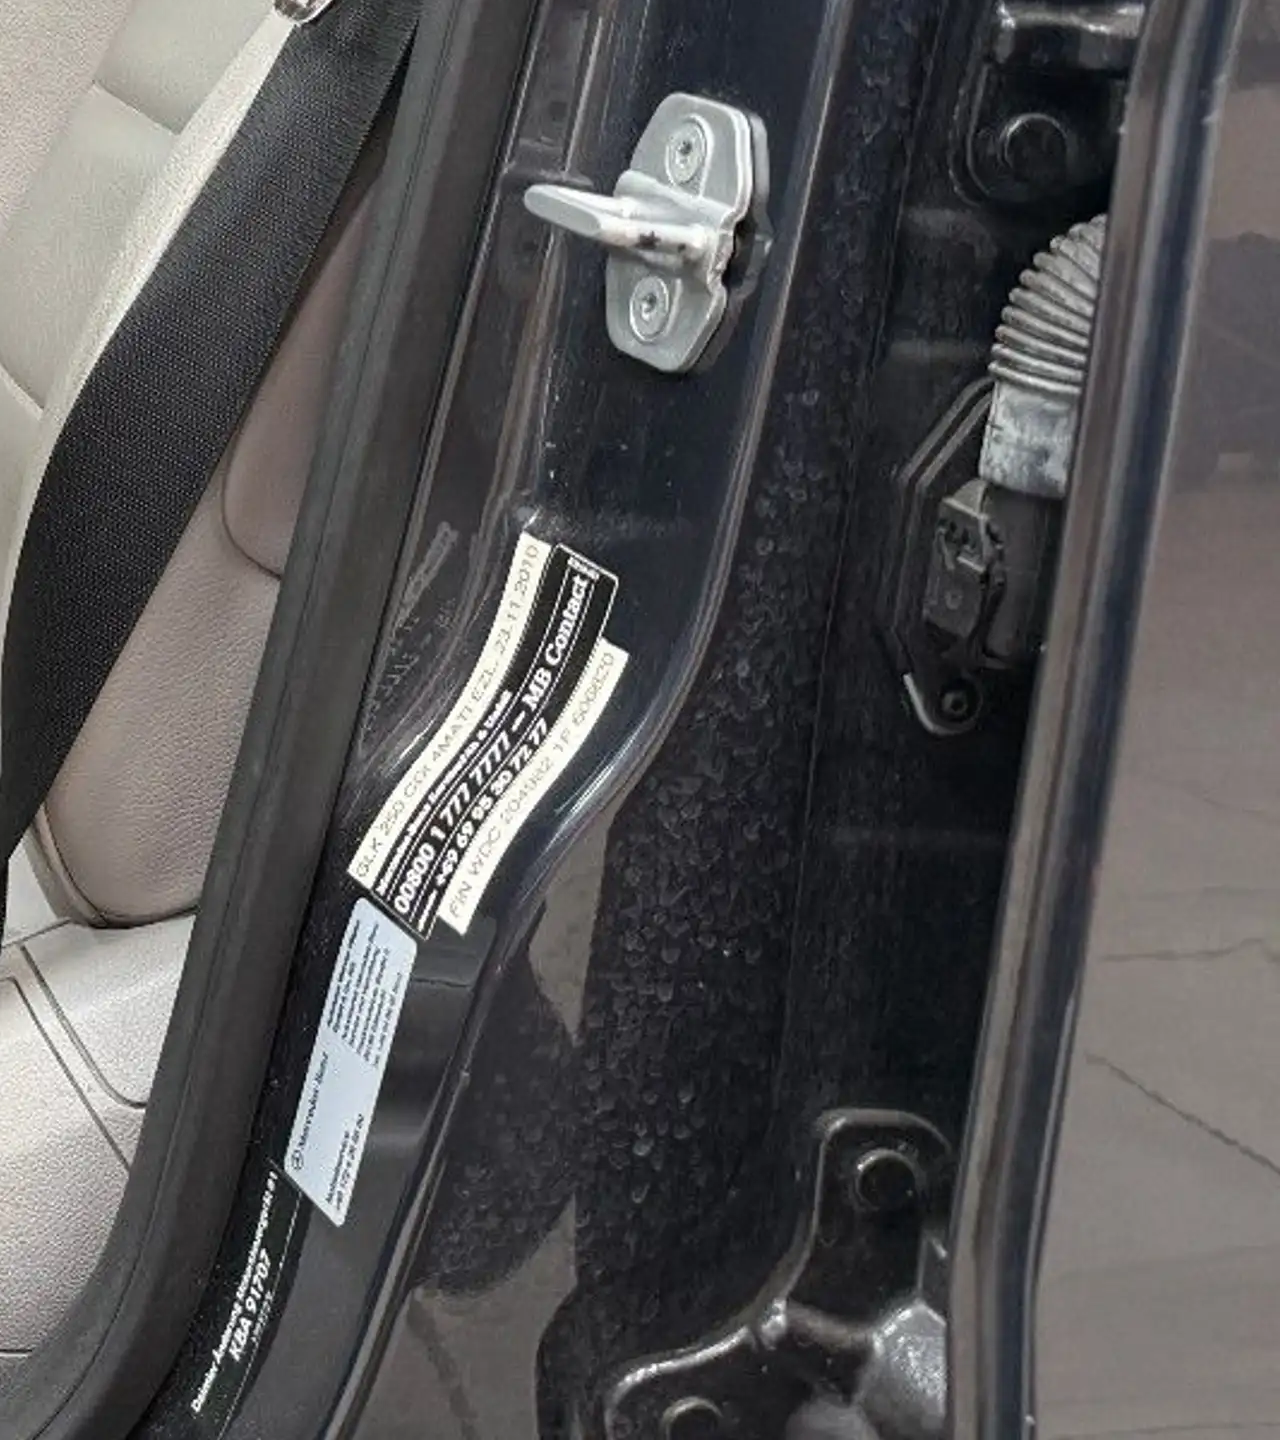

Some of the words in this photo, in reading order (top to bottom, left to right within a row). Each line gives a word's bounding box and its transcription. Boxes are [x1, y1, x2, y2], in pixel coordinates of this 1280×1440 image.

[393, 841, 436, 915] 00800
[429, 825, 447, 840] 1
[439, 781, 471, 827] 777
[468, 729, 512, 786] 7777
[521, 666, 553, 712] MB
[544, 573, 591, 666] Contact
[355, 837, 383, 878] GLK
[227, 1317, 253, 1362] KBA
[244, 1247, 272, 1314] 91707
